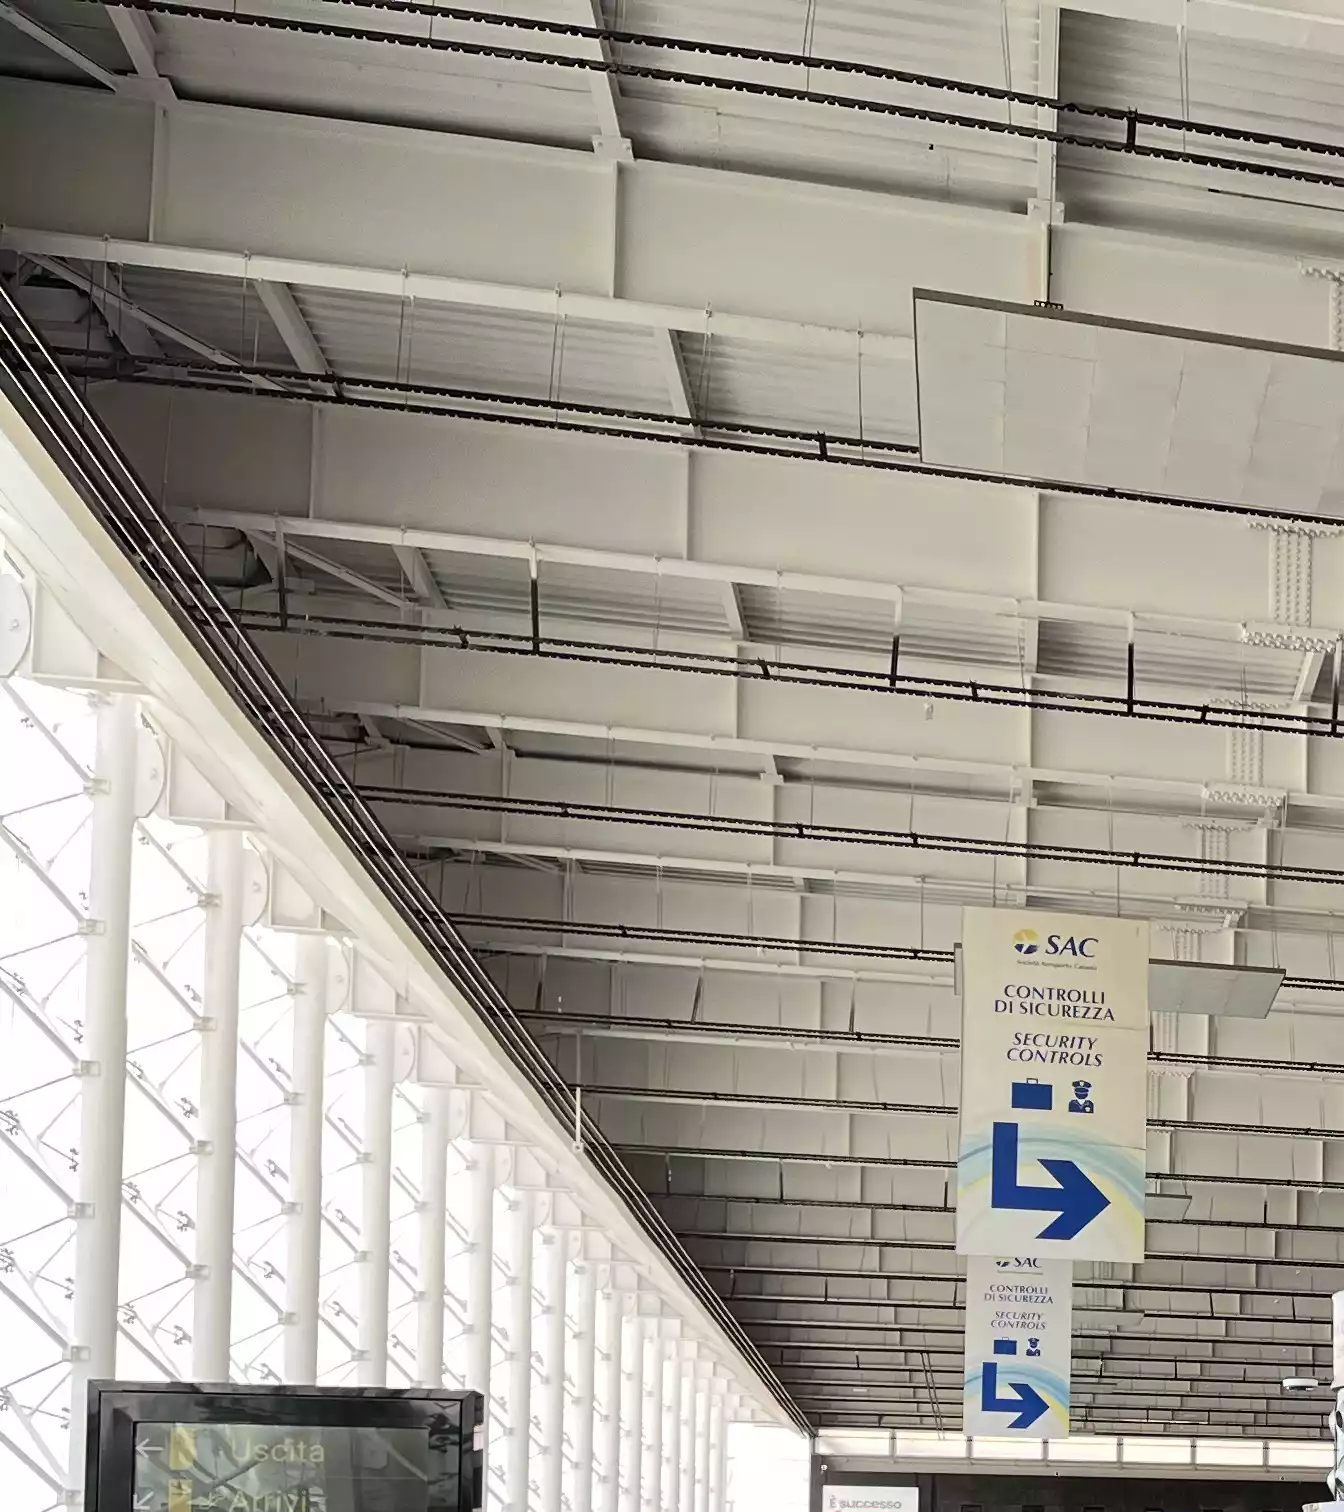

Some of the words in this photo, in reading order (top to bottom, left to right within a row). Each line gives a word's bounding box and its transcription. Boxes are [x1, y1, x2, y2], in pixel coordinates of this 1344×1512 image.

[1044, 934, 1099, 958] SAC
[1004, 984, 1105, 1005] CONTROLLI
[994, 999, 1013, 1014] DI
[1019, 1001, 1116, 1021] SICUREZZA
[1013, 1032, 1098, 1051] SECURITY
[1006, 1048, 1104, 1067] CONTROLS
[984, 1293, 996, 1302] DI
[998, 1294, 1054, 1305] SICUREZZA
[989, 1284, 1048, 1295] CONTROLLI
[990, 1320, 1047, 1331] CONTROLS
[995, 1311, 1044, 1321] SECURITY
[231, 1437, 325, 1463] Uscita
[839, 1499, 902, 1510] successo
